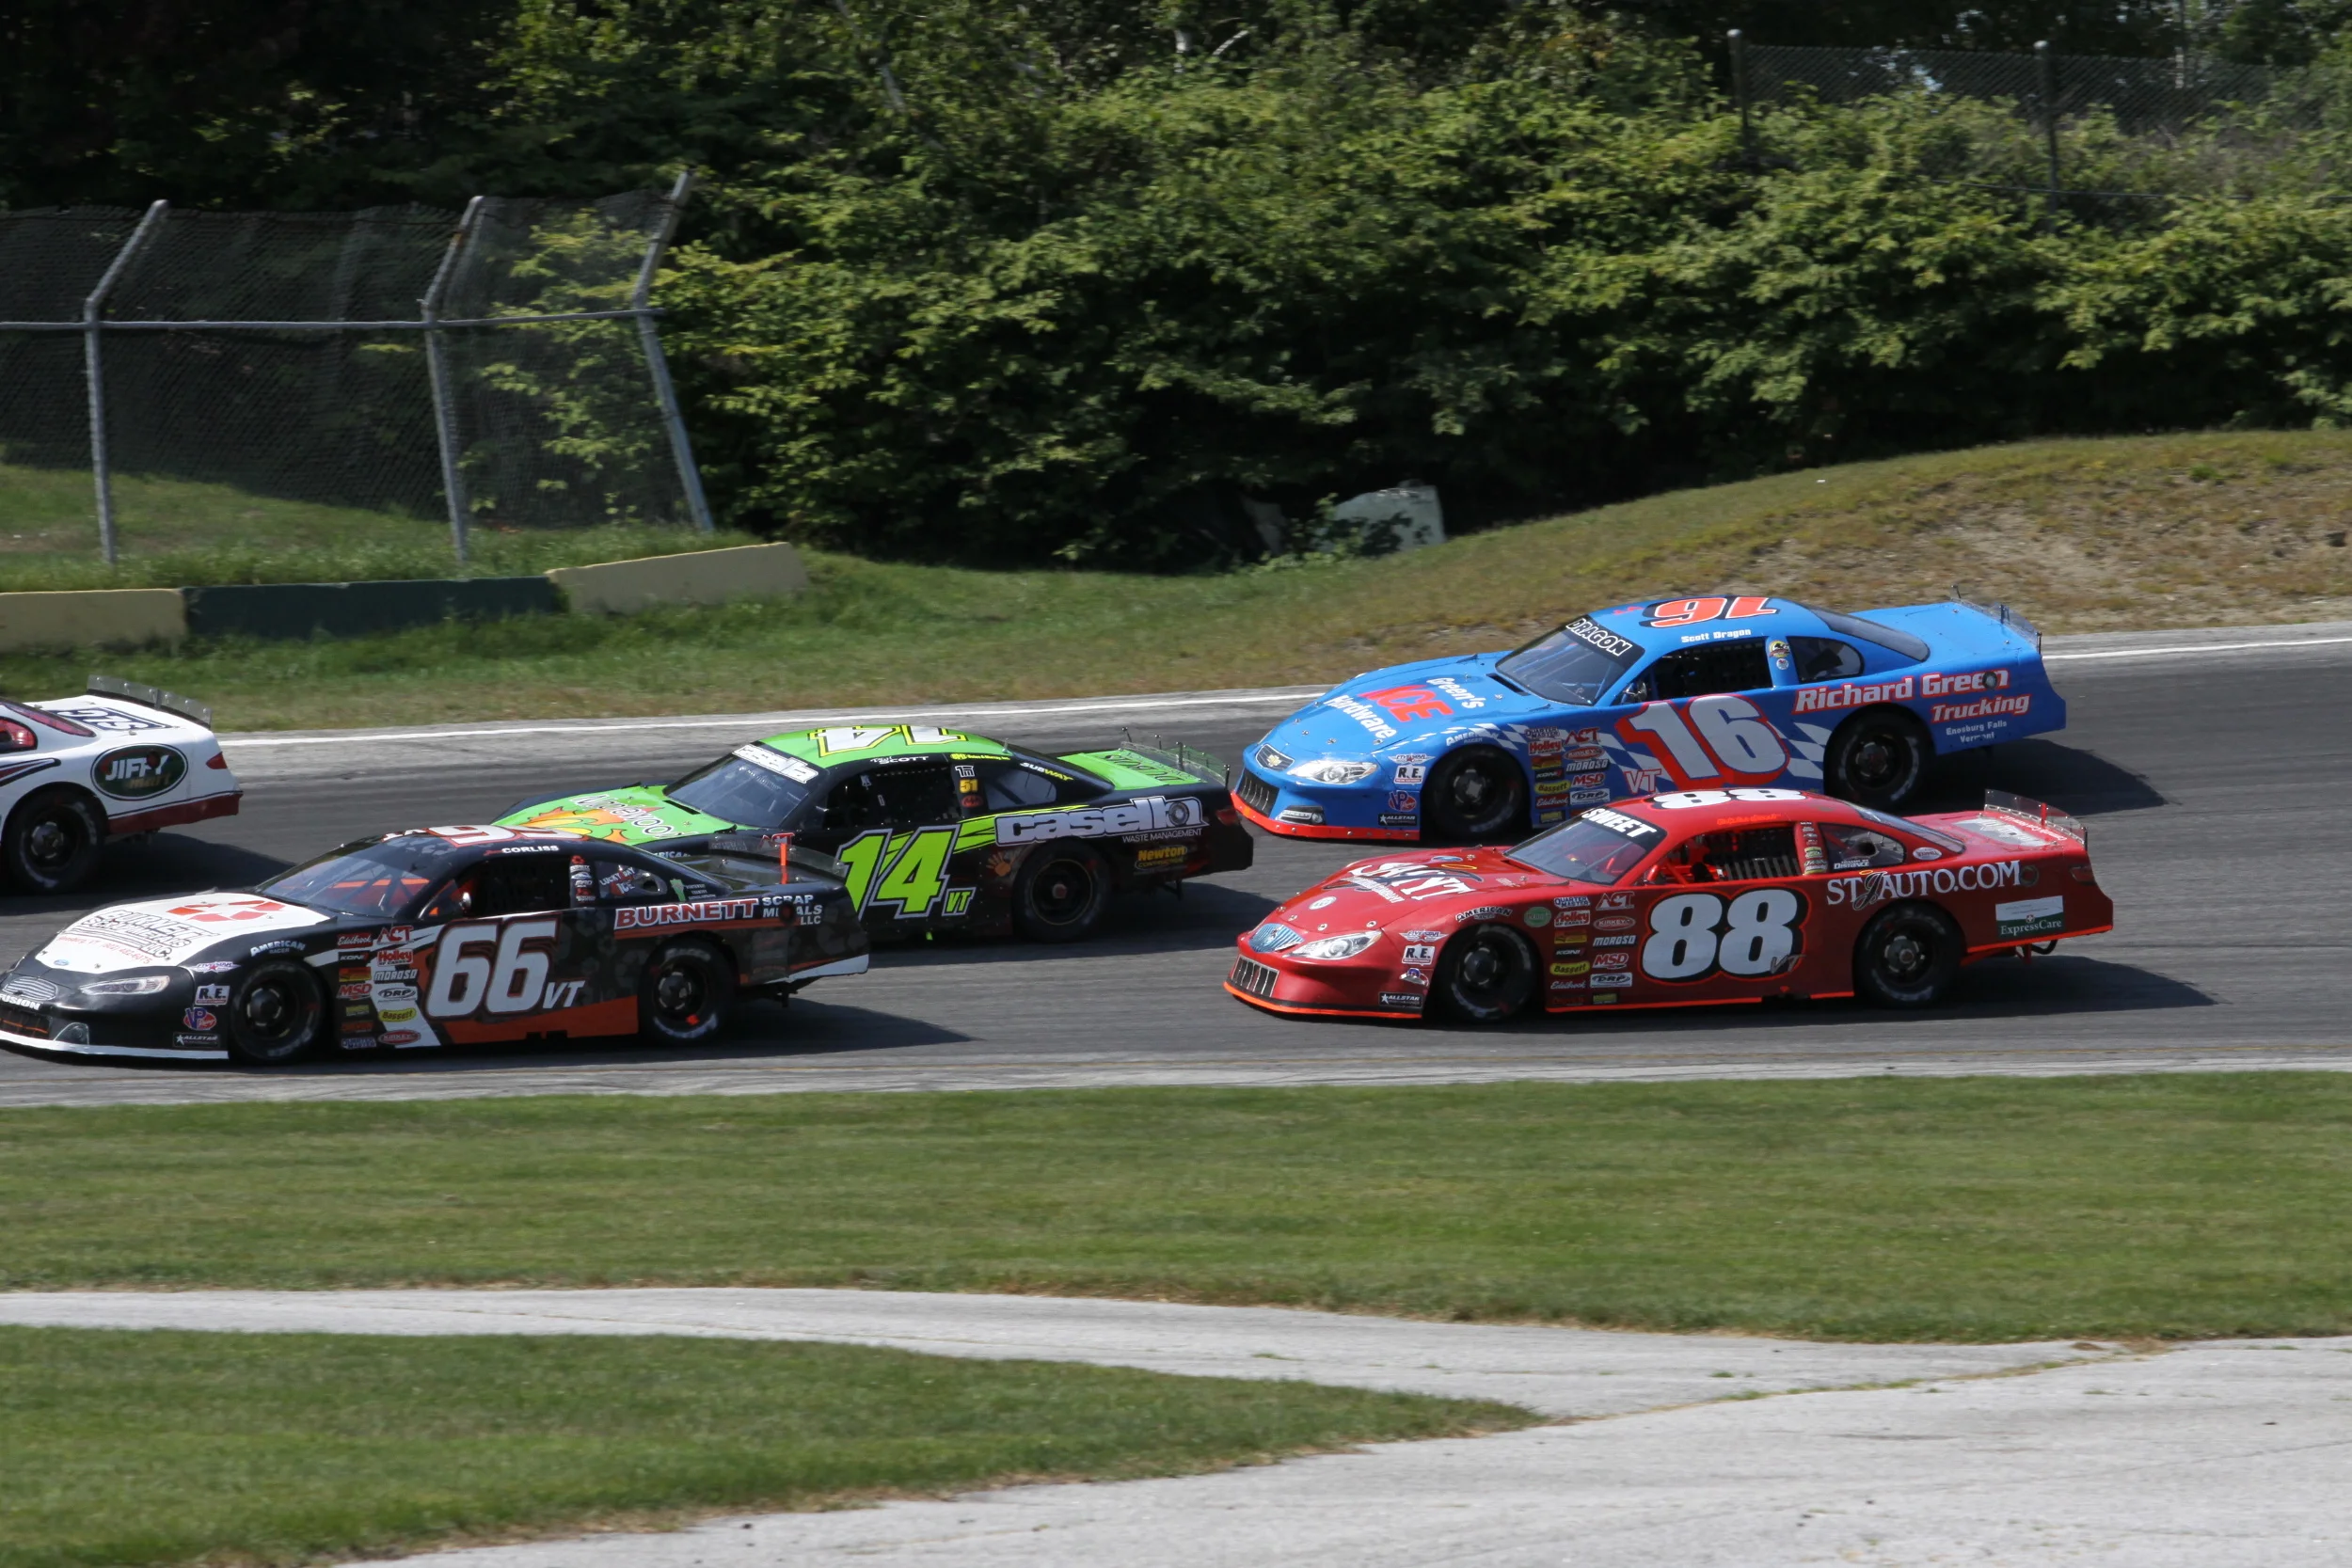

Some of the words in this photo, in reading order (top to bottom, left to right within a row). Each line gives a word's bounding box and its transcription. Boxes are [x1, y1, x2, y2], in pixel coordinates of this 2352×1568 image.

[1565, 617, 1632, 657] DRAGON
[1681, 633, 1709, 643] Scott
[1713, 629, 1752, 641] Dragon
[1426, 677, 1486, 709] Green's
[1794, 677, 1913, 712] Richard
[1323, 694, 1397, 738] Hardware
[1932, 695, 2030, 722] Trucking
[1629, 693, 1788, 780] 16
[1946, 721, 1985, 736] Enosburg
[1987, 720, 2008, 730] Falls
[105, 753, 170, 781] JIFFY
[880, 756, 929, 765] SCOTT
[1566, 759, 1609, 771] MOROSO
[1019, 762, 1074, 782] SUBWAY
[1625, 768, 1661, 794] VT
[1653, 788, 1806, 809] 88
[1581, 807, 1657, 838] SWEET
[1122, 833, 1149, 843] WASTE
[1150, 828, 1203, 841] MANAGEMENT
[501, 845, 560, 854] CORLISS
[1137, 846, 1186, 861] Newton
[599, 871, 622, 885] LUCKY
[837, 824, 961, 921] 14
[762, 895, 814, 906] SCRAP
[944, 888, 975, 916] VT
[614, 898, 758, 929] BURNETT
[800, 915, 822, 926] LLC
[1455, 906, 1513, 921] AMERICAN
[1643, 888, 1799, 979] 88
[2001, 920, 2062, 936] ExpressCare
[250, 940, 306, 957] AMERICAN
[1593, 935, 1637, 946] MOROSO
[378, 948, 412, 961] Holley
[426, 918, 558, 1018] 66
[1770, 955, 1806, 974] VT
[376, 969, 419, 980] MOROSO
[543, 979, 585, 1009] VT
[1550, 981, 1586, 990] Edelbrock
[383, 1009, 413, 1019] Bassett
